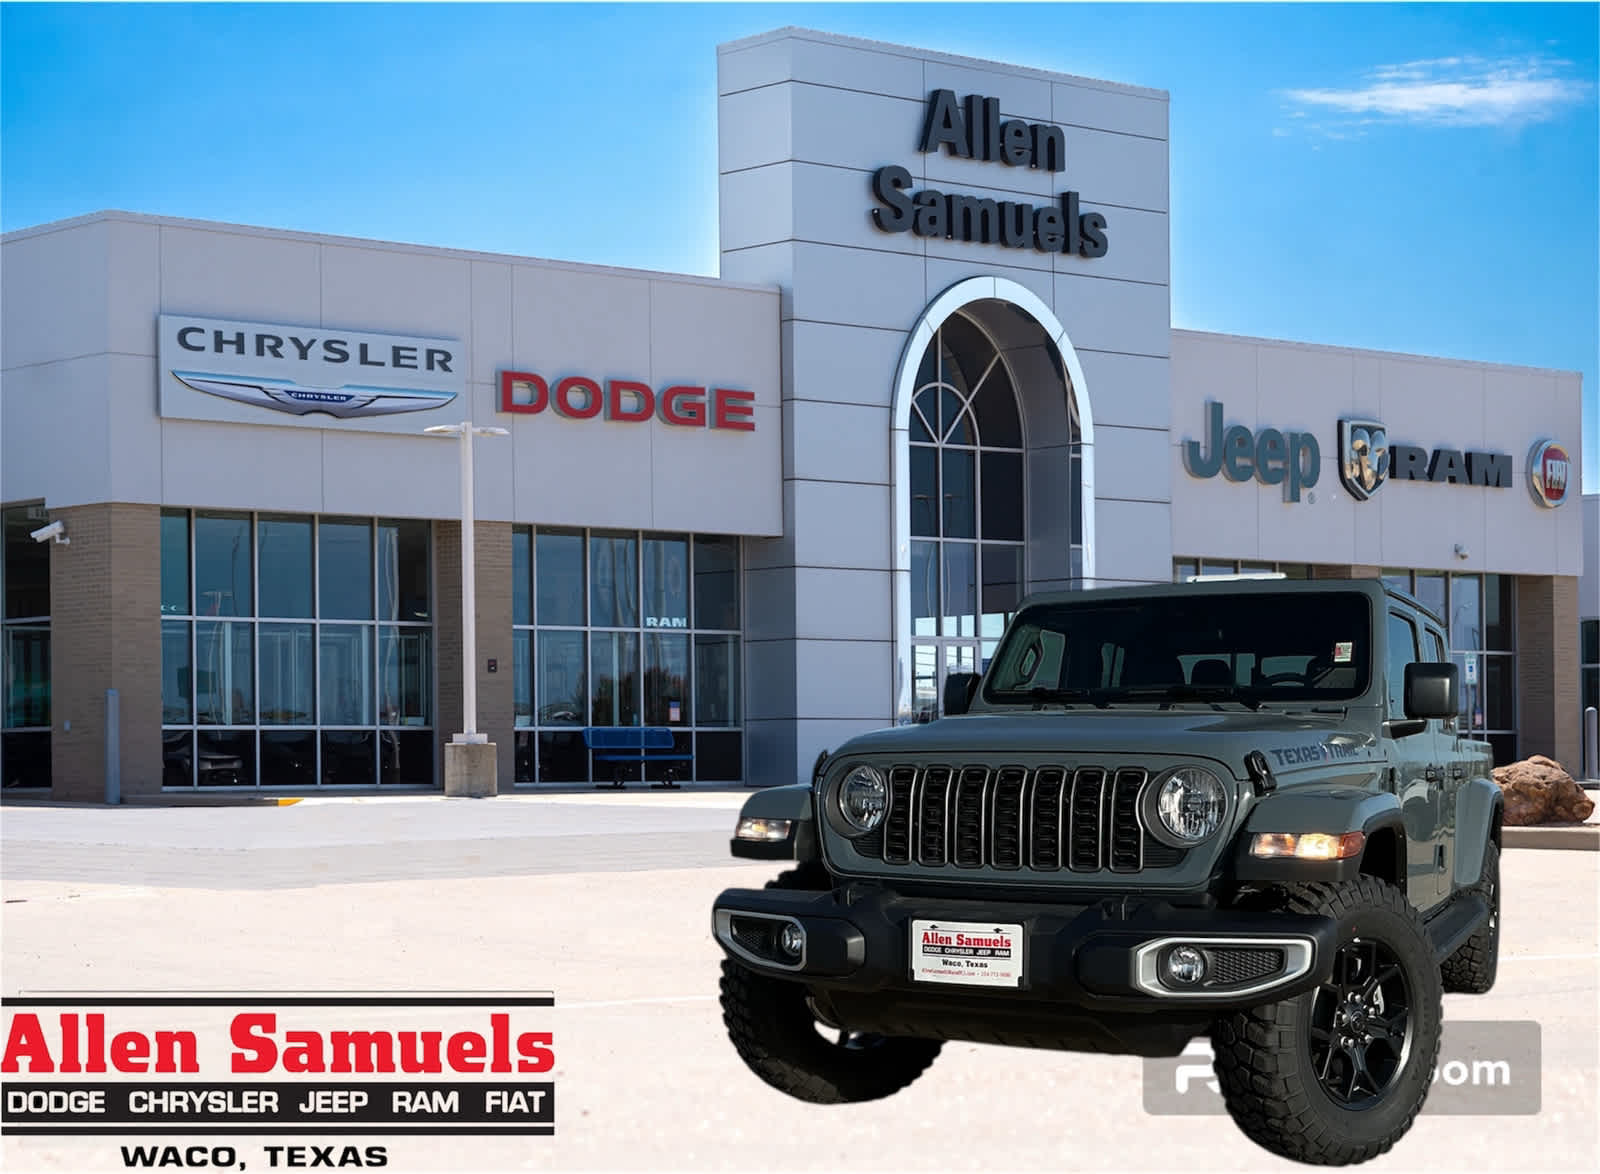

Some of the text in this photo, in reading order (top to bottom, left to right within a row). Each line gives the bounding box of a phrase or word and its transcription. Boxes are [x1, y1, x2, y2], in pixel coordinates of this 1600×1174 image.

[919, 88, 1066, 172] Allen
[871, 165, 1109, 258] Samuels
[176, 326, 454, 373] CHRYSLER
[291, 392, 347, 401] CHRYSLER
[495, 370, 756, 432] DODGE
[1182, 400, 1321, 503] Jeep
[1389, 444, 1513, 488] RAM
[1545, 458, 1567, 489] FIAT
[645, 616, 687, 628] RAM
[1269, 746, 1320, 766] TEXAS
[922, 932, 1011, 947] Allen Samuels
[942, 959, 963, 968] Waco,
